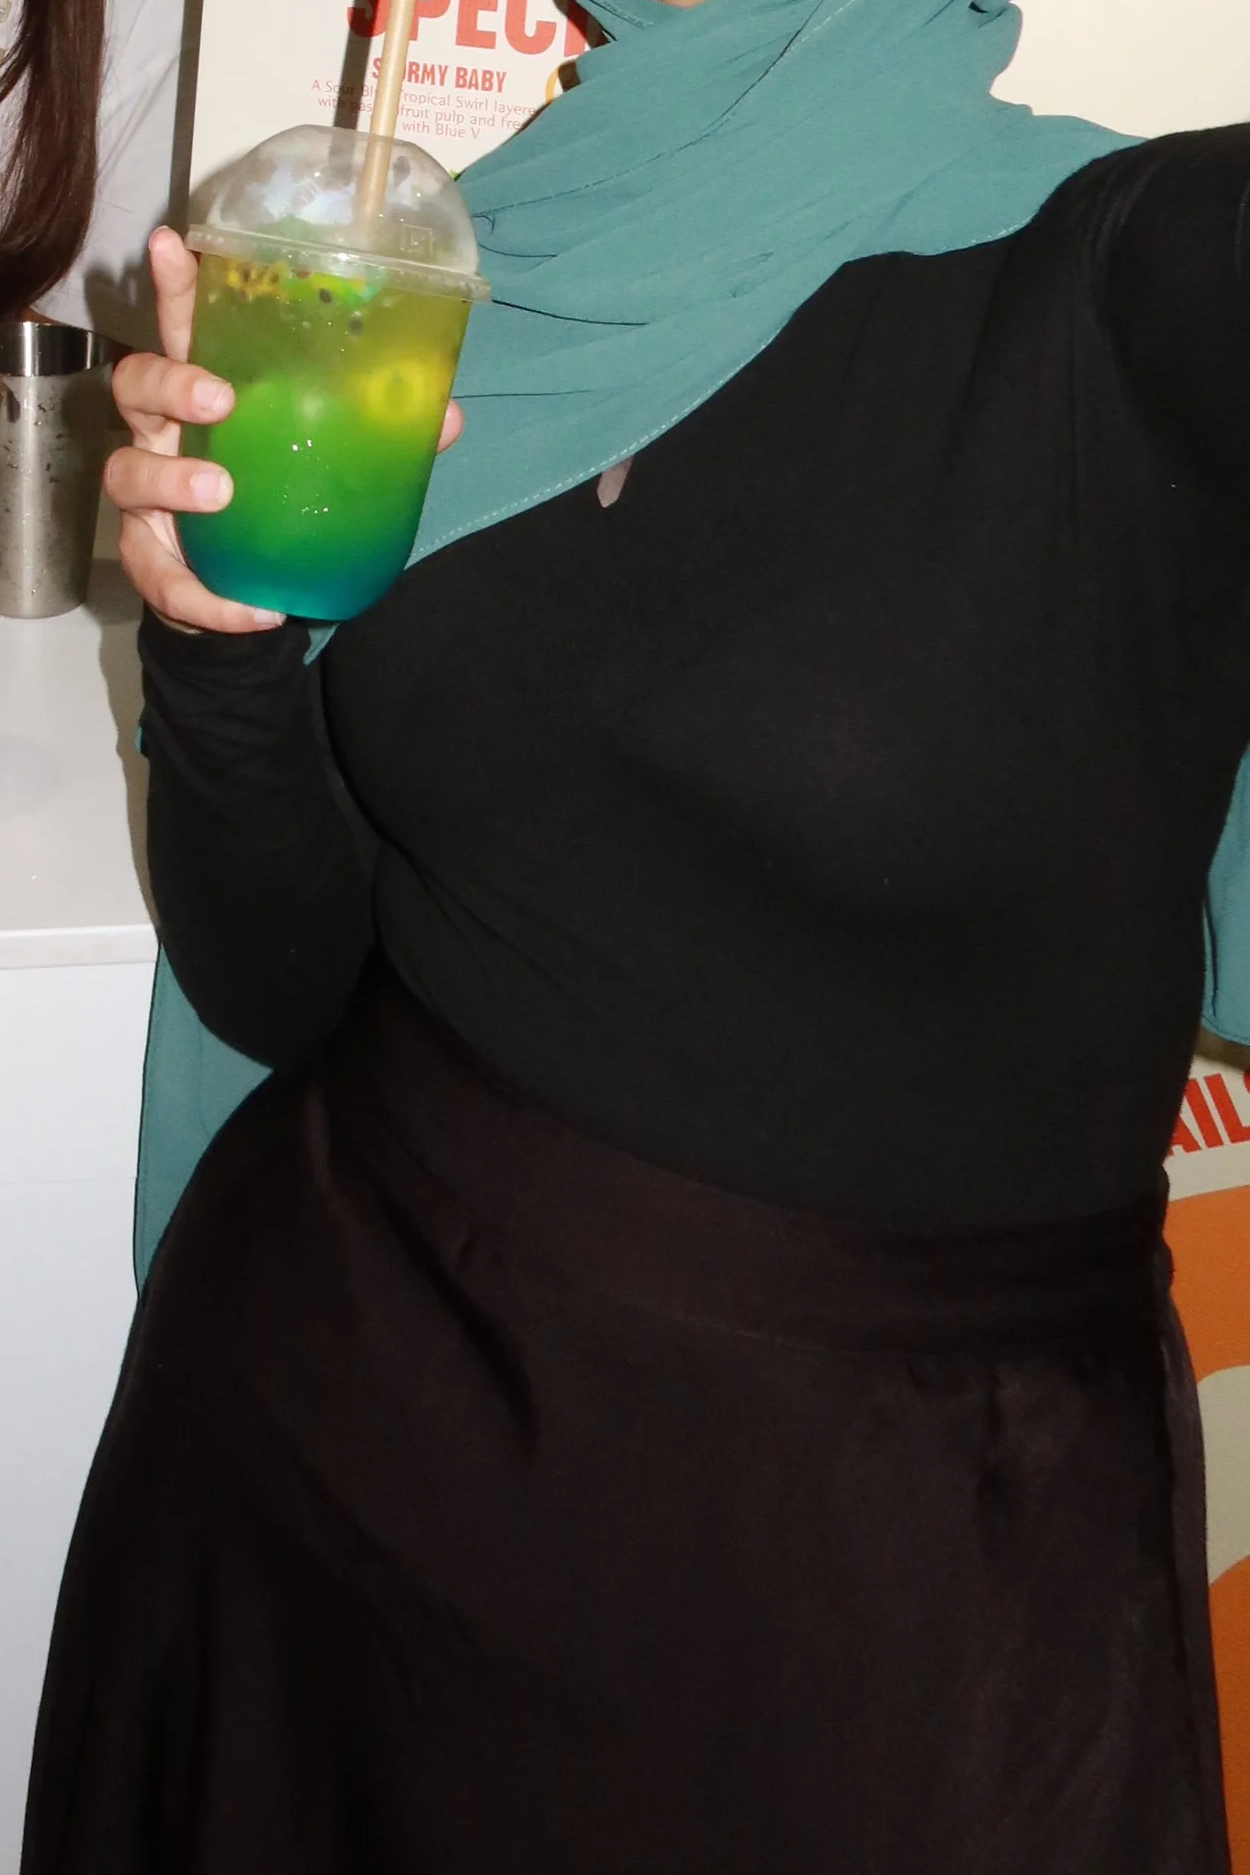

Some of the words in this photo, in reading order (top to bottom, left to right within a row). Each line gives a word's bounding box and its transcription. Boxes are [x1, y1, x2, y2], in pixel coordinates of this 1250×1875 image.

[371, 58, 448, 86] SRMY
[454, 66, 507, 93] BABY
[311, 79, 321, 91] A
[401, 89, 450, 108] ropical
[456, 95, 488, 110] Swirl
[494, 100, 537, 118] layere
[318, 96, 346, 109] with
[435, 109, 464, 126] pulp
[470, 114, 495, 128] and
[402, 121, 430, 134] with
[436, 123, 466, 138] Blue
